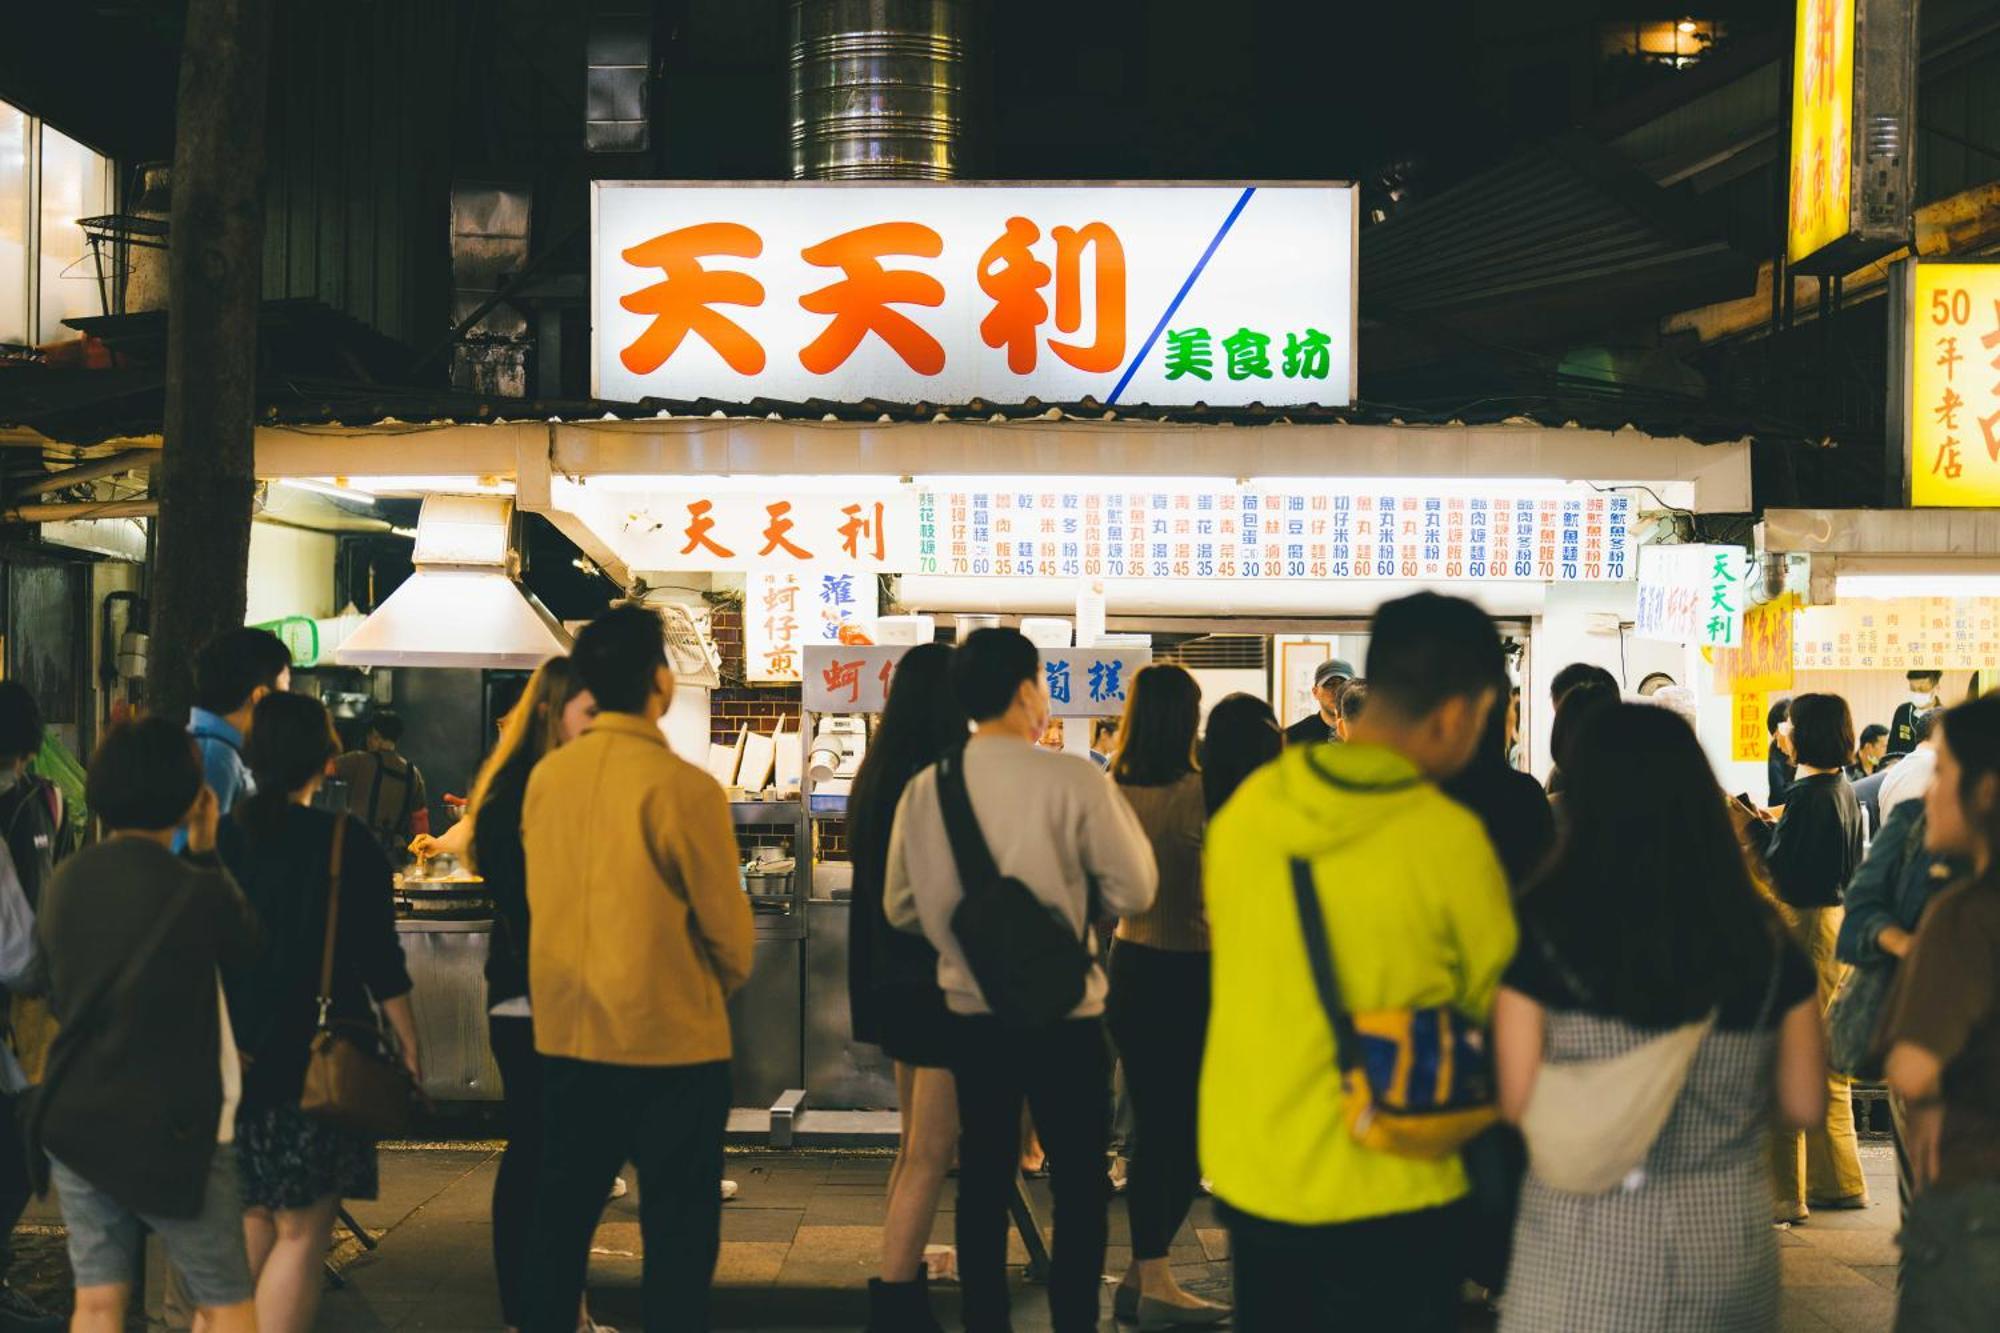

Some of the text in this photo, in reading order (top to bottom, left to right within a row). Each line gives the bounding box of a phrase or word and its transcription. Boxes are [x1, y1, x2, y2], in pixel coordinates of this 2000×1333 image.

[620, 216, 1331, 382] 天天利 美食坊
[1931, 288, 1970, 479] 50年老店
[1242, 495, 1258, 544] 荷包蛋
[680, 498, 885, 561] 天天利
[920, 558, 936, 573] 70
[952, 558, 968, 573] 70
[973, 558, 989, 574] 60
[995, 559, 1011, 575] 35
[1017, 560, 1034, 575] 45
[1040, 560, 1056, 575] 45
[1062, 560, 1079, 575] 45
[1085, 560, 1101, 575] 60
[1107, 560, 1123, 575] 70
[1128, 560, 1145, 576] 35
[1153, 561, 1169, 576] 35
[1173, 561, 1190, 576] 45
[1197, 561, 1213, 576] 35
[1218, 561, 1235, 576] 45
[1242, 561, 1260, 576] 30
[1265, 561, 1281, 576] 30
[1288, 561, 1305, 576] 30
[1310, 562, 1327, 576] 45
[1333, 562, 1349, 576] 45
[1354, 561, 1371, 576] 60
[1377, 561, 1395, 576] 60
[1402, 562, 1418, 577] 60
[1426, 563, 1438, 574] 60
[1446, 562, 1462, 577] 60
[1469, 562, 1486, 577] 60
[1490, 562, 1507, 577] 60
[1515, 561, 1531, 577] 60
[1538, 562, 1554, 577] 70
[1562, 564, 1577, 579] 70
[1584, 563, 1600, 578] 70
[1607, 563, 1624, 578] 70
[1706, 553, 1738, 644] 天天利
[762, 586, 801, 677] 蚵仔煎
[1861, 656, 1872, 666] 45
